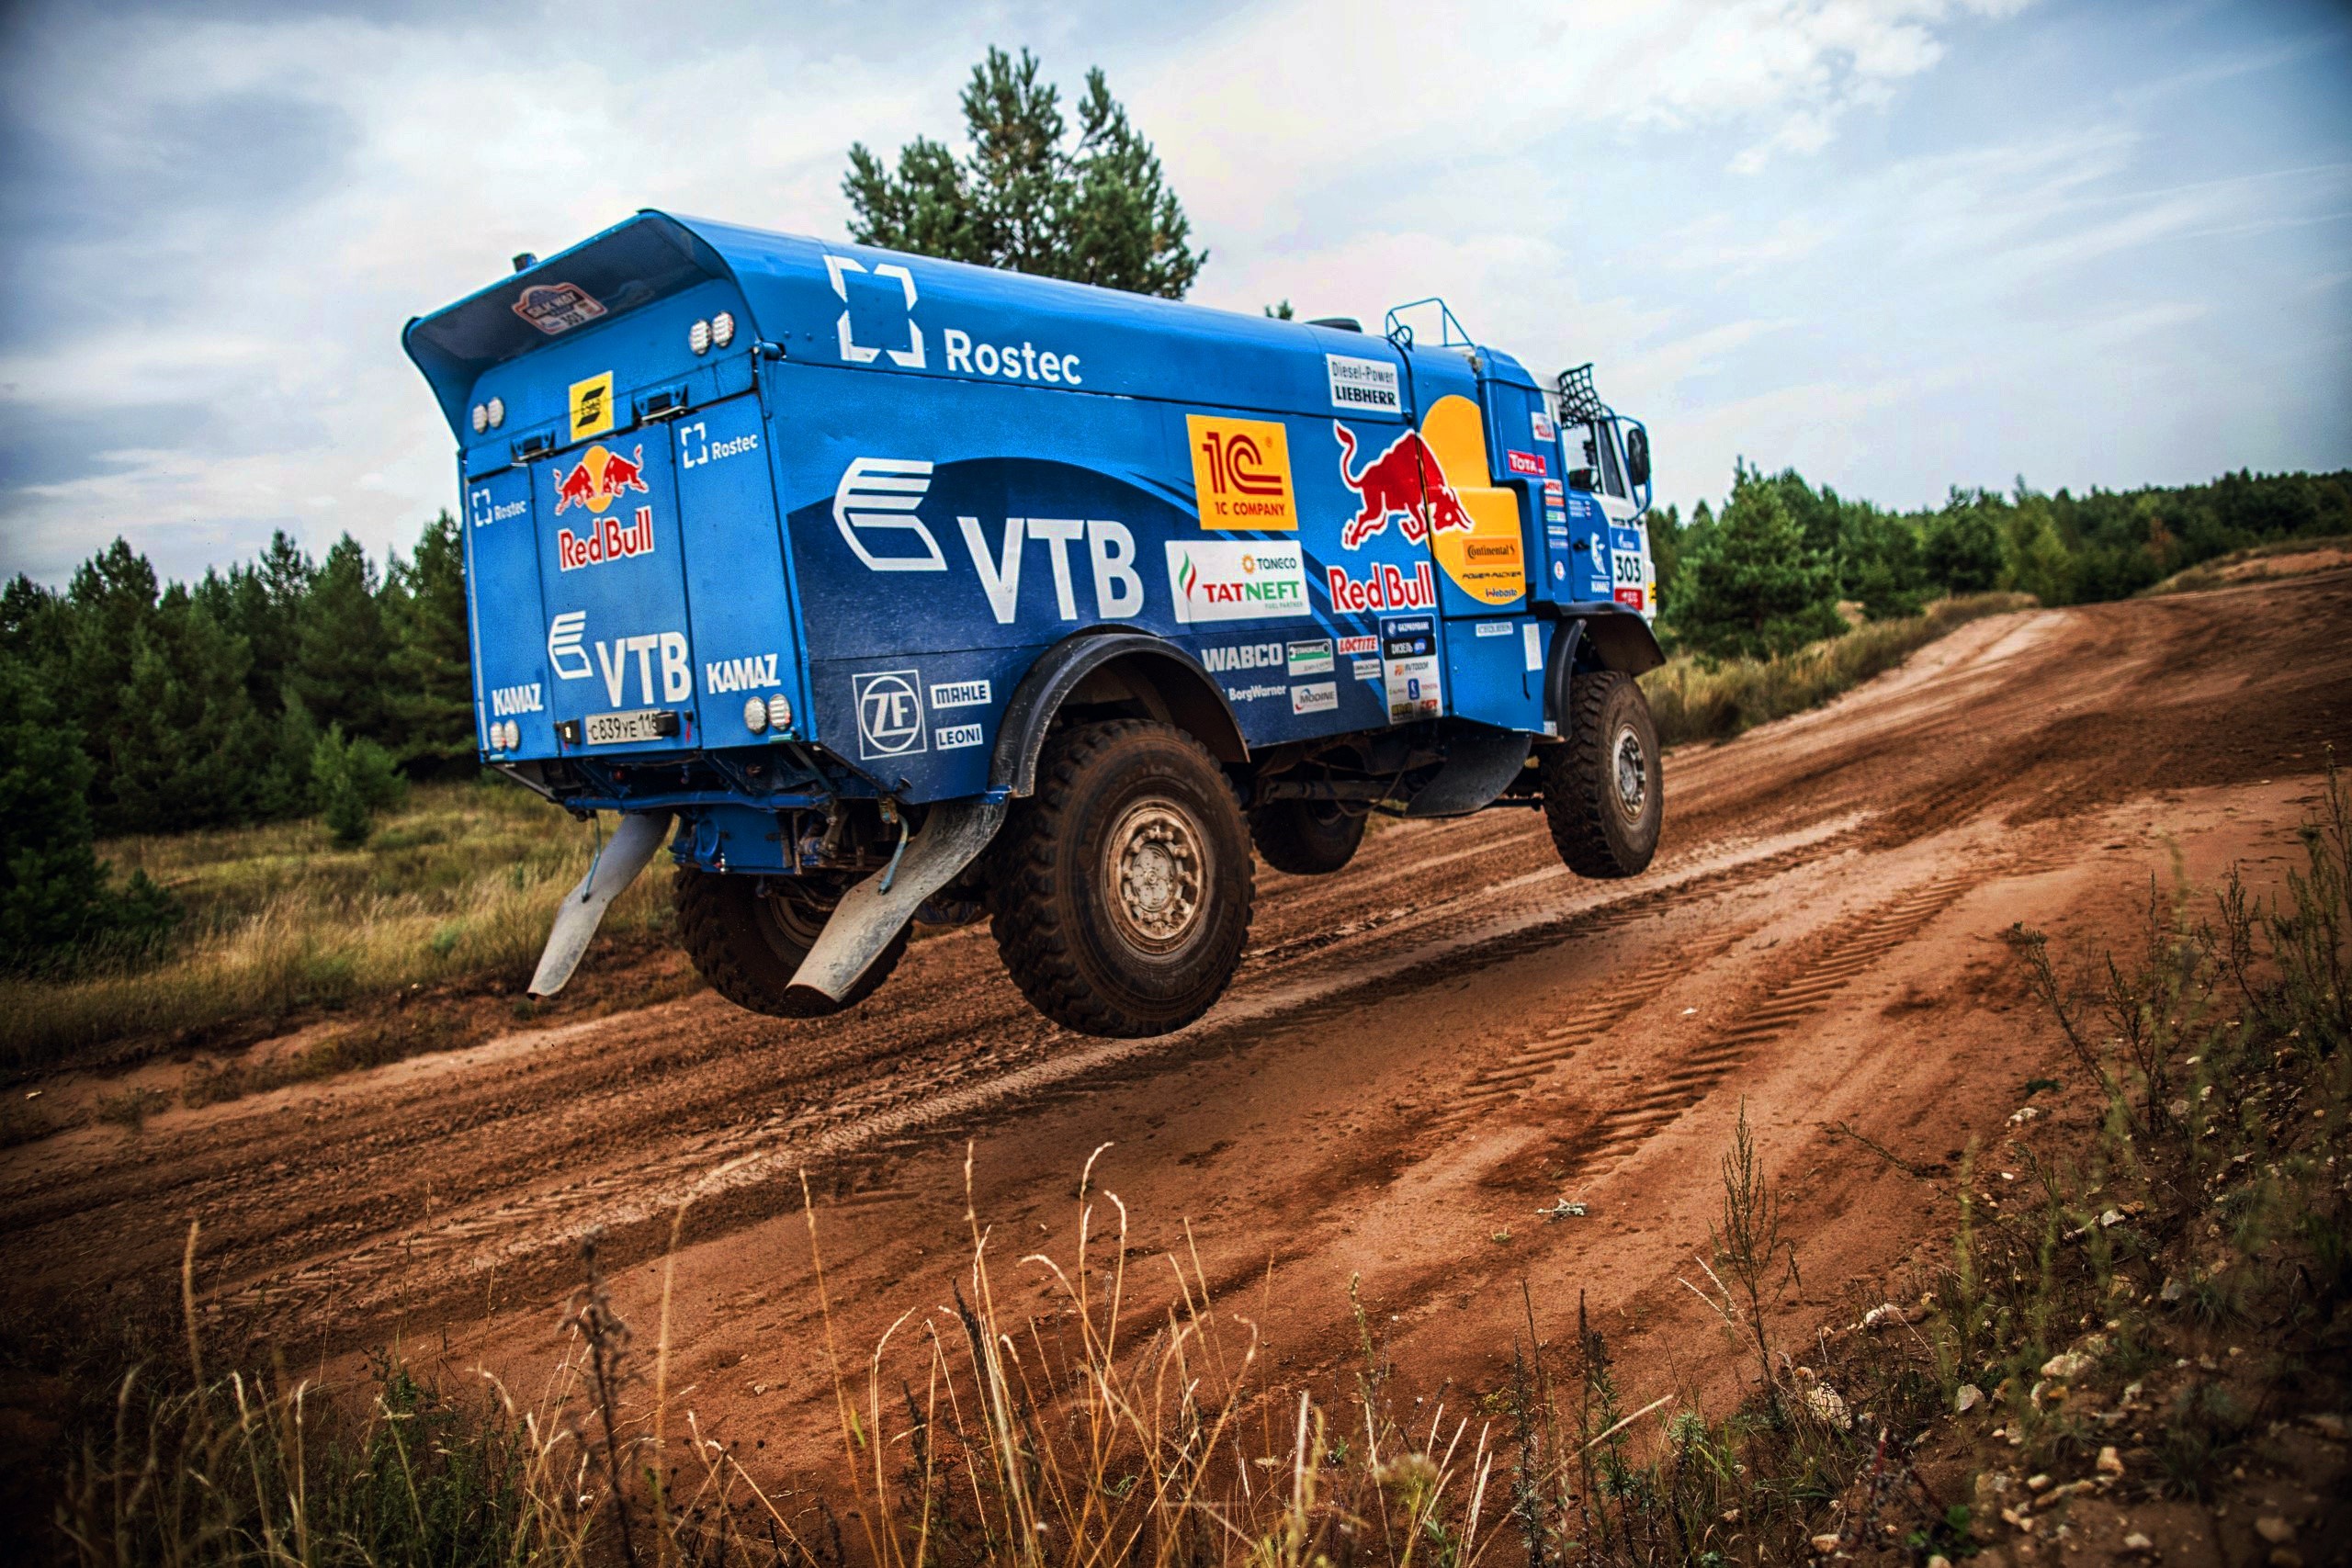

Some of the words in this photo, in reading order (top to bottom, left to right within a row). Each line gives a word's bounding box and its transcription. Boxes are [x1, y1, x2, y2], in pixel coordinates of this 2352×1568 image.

[944, 328, 1082, 385] Rostec
[1331, 361, 1395, 383] Diesel-Power
[1335, 385, 1396, 405] LIEBHERR
[711, 434, 759, 460] Rostec
[1509, 454, 1545, 474] TOTAL
[493, 501, 527, 521] Rostec
[1215, 502, 1228, 515] 1C
[1233, 502, 1285, 516] COMPANY
[559, 519, 603, 571] Red
[604, 507, 653, 561] Bull
[1467, 544, 1510, 559] Continental
[956, 515, 1145, 625] VTB
[1615, 555, 1642, 582] 303
[1202, 581, 1300, 604] TATNEFT
[1329, 563, 1385, 613] Red
[1384, 561, 1436, 611] Bull
[1339, 637, 1377, 653] LOCTITE
[595, 631, 692, 707] VTB
[1201, 643, 1284, 672] WABCO
[706, 653, 781, 694] KAMAZ
[492, 682, 544, 716] KAMAZ
[935, 684, 987, 705] MAHLE
[1228, 684, 1287, 702] BorgWarner
[1300, 691, 1335, 704] MODINE
[865, 691, 916, 738] ZF
[938, 728, 981, 746] LEONI
